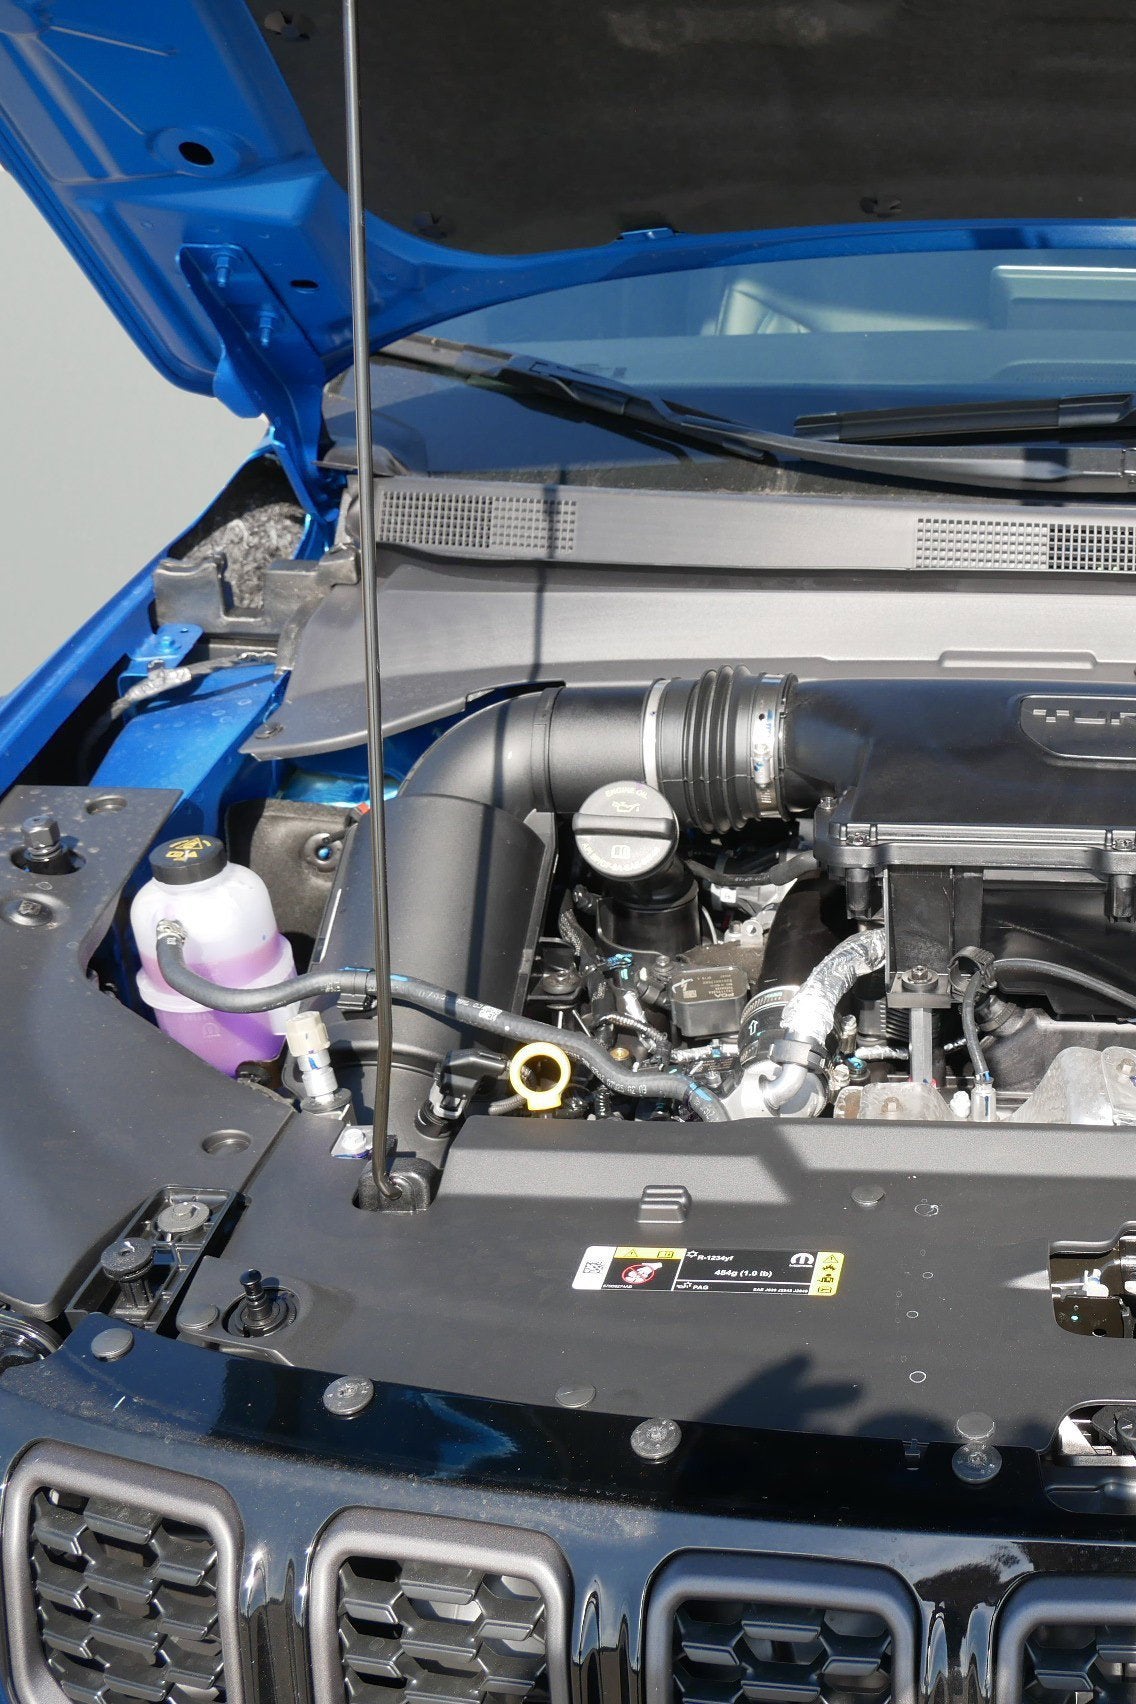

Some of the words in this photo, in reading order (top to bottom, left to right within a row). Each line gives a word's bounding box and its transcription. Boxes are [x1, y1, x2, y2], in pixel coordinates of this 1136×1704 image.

[605, 786, 635, 798] ENGINE
[697, 1255, 734, 1263] R-1234yf
[740, 1269, 758, 1278] (1.0
[759, 1270, 773, 1278] lb)
